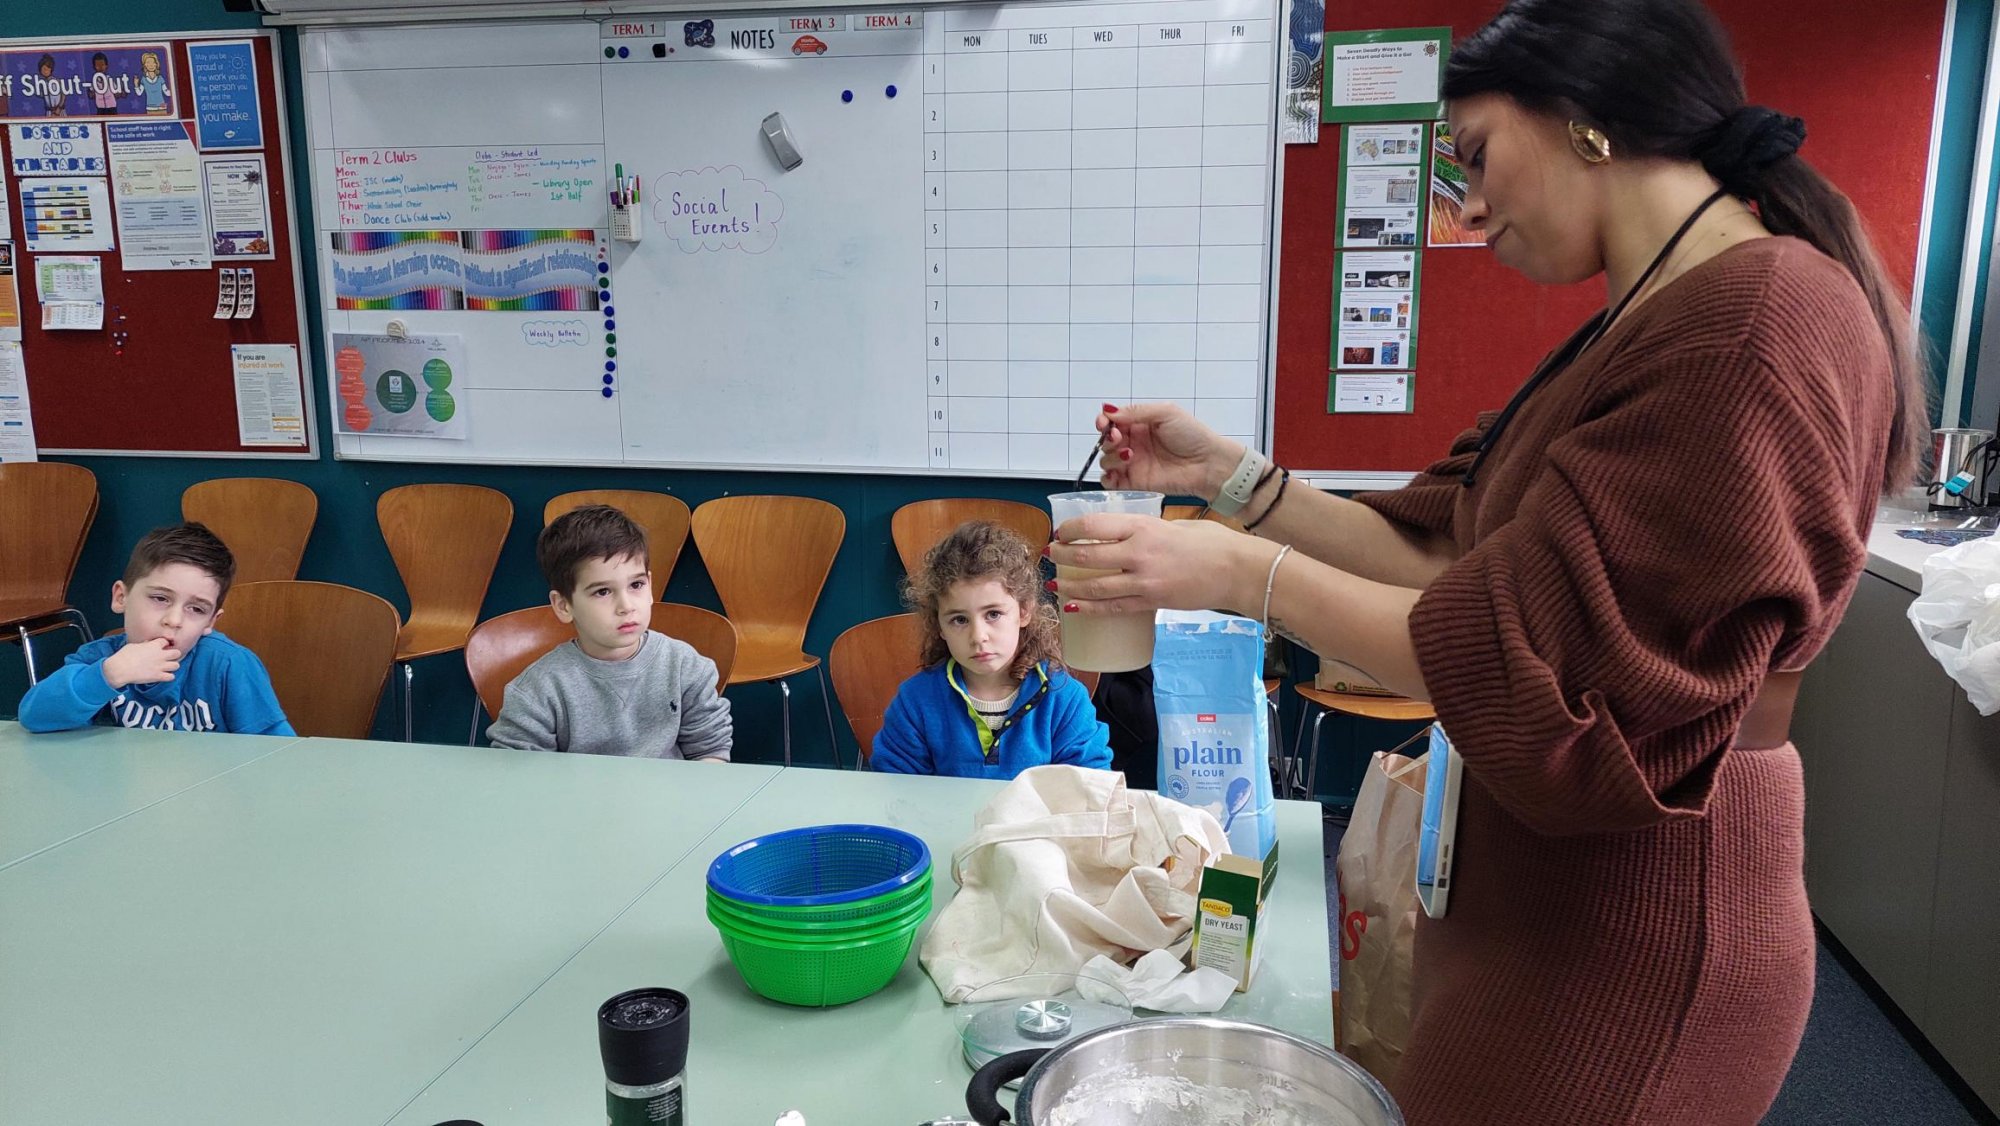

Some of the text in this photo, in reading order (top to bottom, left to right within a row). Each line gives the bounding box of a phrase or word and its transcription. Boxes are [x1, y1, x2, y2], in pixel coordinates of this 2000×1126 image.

[789, 18, 835, 30] TERM 3
[865, 15, 912, 27] TERM 4
[612, 24, 655, 35] TERM 1
[1160, 28, 1182, 40] THUR
[1232, 26, 1245, 37] FRI
[730, 29, 775, 49] NOTES
[963, 36, 981, 47] MON
[1028, 33, 1048, 45] TUES
[1094, 31, 1113, 43] WED
[196, 62, 217, 74] proud
[208, 73, 227, 81] work
[228, 74, 239, 82] you
[21, 72, 131, 96] Shout-Out
[208, 83, 236, 93] person
[237, 84, 248, 92] you
[201, 102, 236, 110] difference
[202, 112, 220, 125] you
[932, 111, 937, 122] 2
[43, 142, 73, 156] AND
[500, 149, 522, 158] Student
[527, 148, 538, 157] Led
[338, 150, 418, 165] Term 2 Clubs
[932, 150, 937, 161] 3
[14, 156, 105, 172] TIMETABLES
[543, 180, 570, 189] Library
[574, 178, 593, 190] Open
[568, 191, 582, 202] Half
[932, 186, 938, 197] 4
[672, 188, 730, 216] Social
[364, 212, 390, 224] Dance
[394, 214, 412, 224] Club
[933, 224, 938, 234] 5
[332, 251, 462, 292] No significant learning occurs
[464, 262, 495, 287] without
[496, 271, 502, 287] a
[503, 253, 546, 289] significant
[934, 263, 938, 274] 6
[934, 301, 939, 312] 7
[529, 329, 554, 342] Weekly
[934, 336, 940, 346] 8
[242, 354, 254, 362] you
[935, 374, 940, 385] 9
[934, 410, 943, 420] 10
[934, 447, 942, 457] 11
[1182, 727, 1232, 737] AUSTRALIAN
[1173, 740, 1244, 770] plain
[1192, 769, 1225, 778] FLOUR
[1202, 901, 1232, 913] TANDACO
[1204, 918, 1244, 932] DRY YEAST
